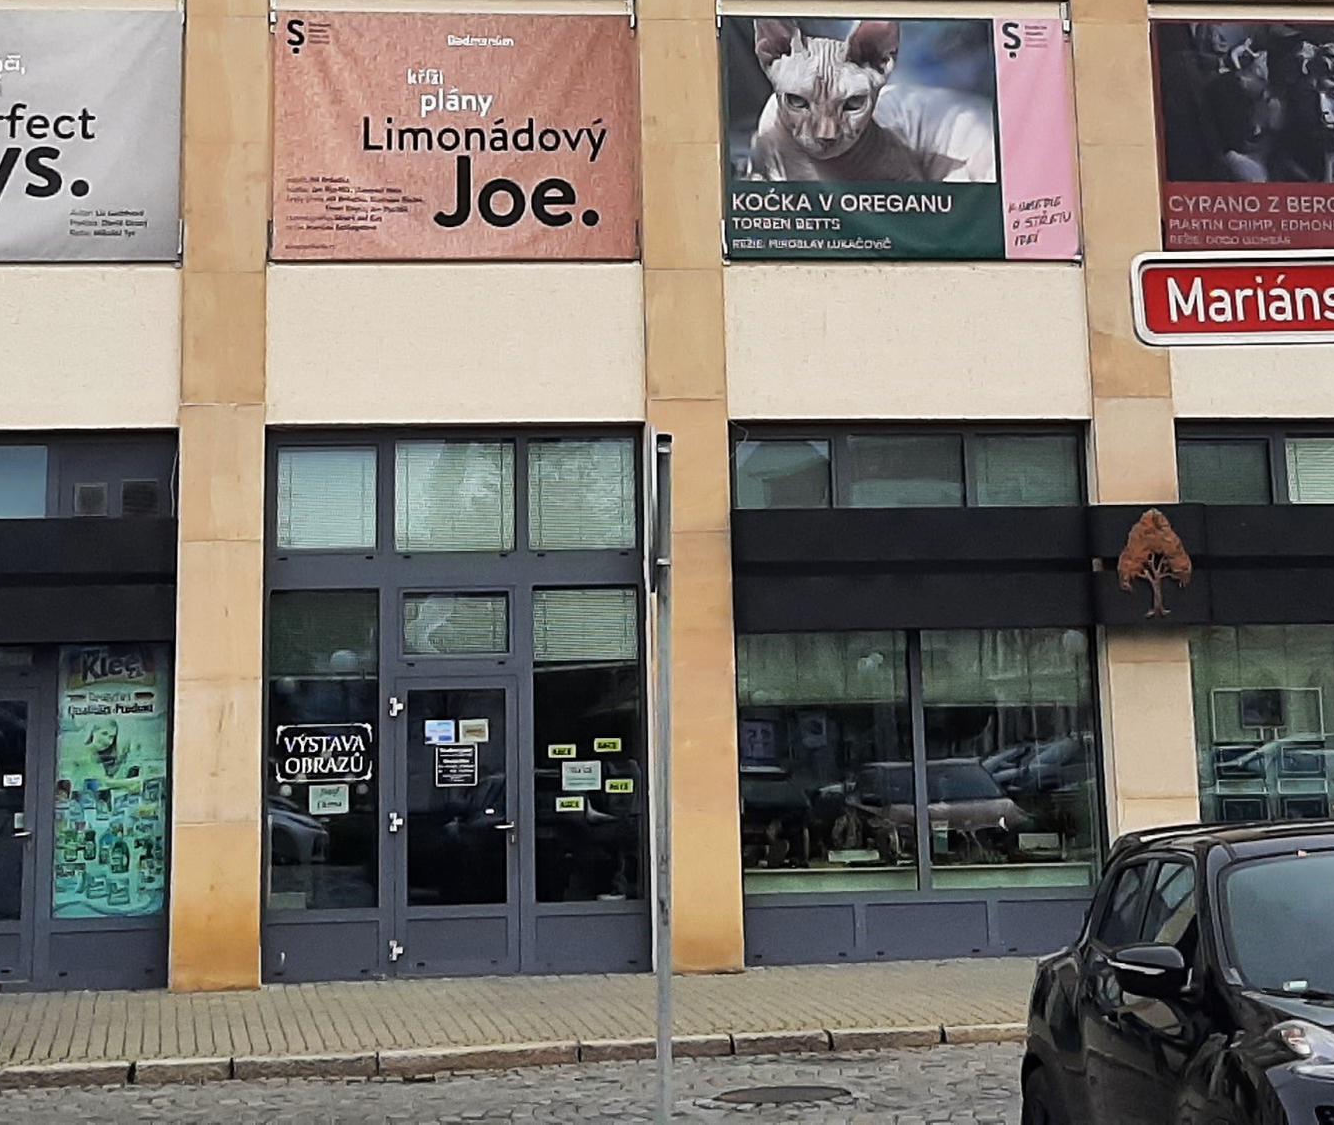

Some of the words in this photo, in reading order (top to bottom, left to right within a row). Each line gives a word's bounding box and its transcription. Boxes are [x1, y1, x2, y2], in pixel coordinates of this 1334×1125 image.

[420, 86, 493, 118] plány
[362, 116, 607, 162] Limonádový
[433, 154, 601, 228] Joe.
[731, 187, 812, 212] KOČKA
[819, 194, 834, 211] V
[840, 193, 953, 213] OREGANU
[1168, 195, 1261, 214] CYRANO
[1267, 195, 1280, 213] Z
[731, 217, 791, 231] TORBEN
[1169, 218, 1223, 231] MARTIN
[284, 733, 366, 753] VÝSTAVA
[285, 751, 363, 774] OBRAZŮ
